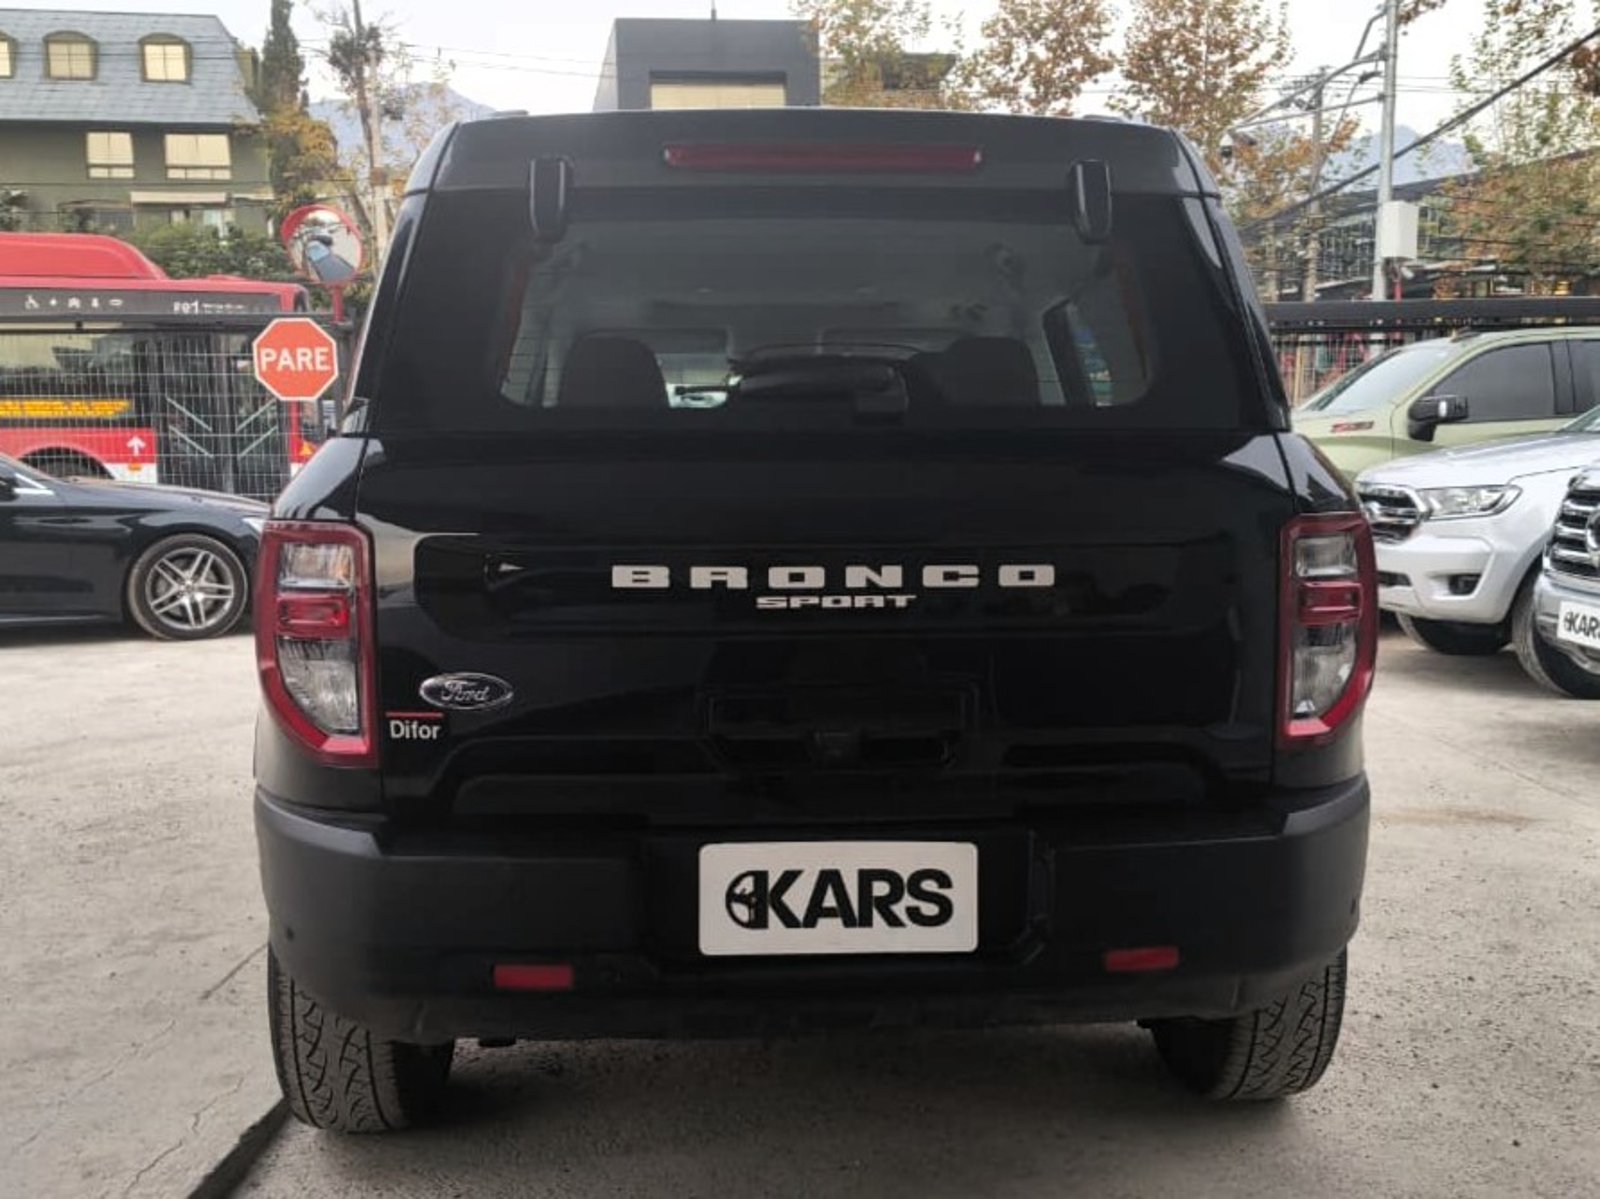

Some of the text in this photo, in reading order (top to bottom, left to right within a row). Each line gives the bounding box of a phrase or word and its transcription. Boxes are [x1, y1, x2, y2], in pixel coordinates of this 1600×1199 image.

[260, 347, 331, 372] PARE
[611, 564, 1056, 589] BRONCO
[756, 595, 917, 609] SPORT
[1569, 612, 1600, 640] KAR
[441, 680, 491, 701] Ford
[389, 719, 441, 740] Difor
[752, 868, 954, 929] KARS
